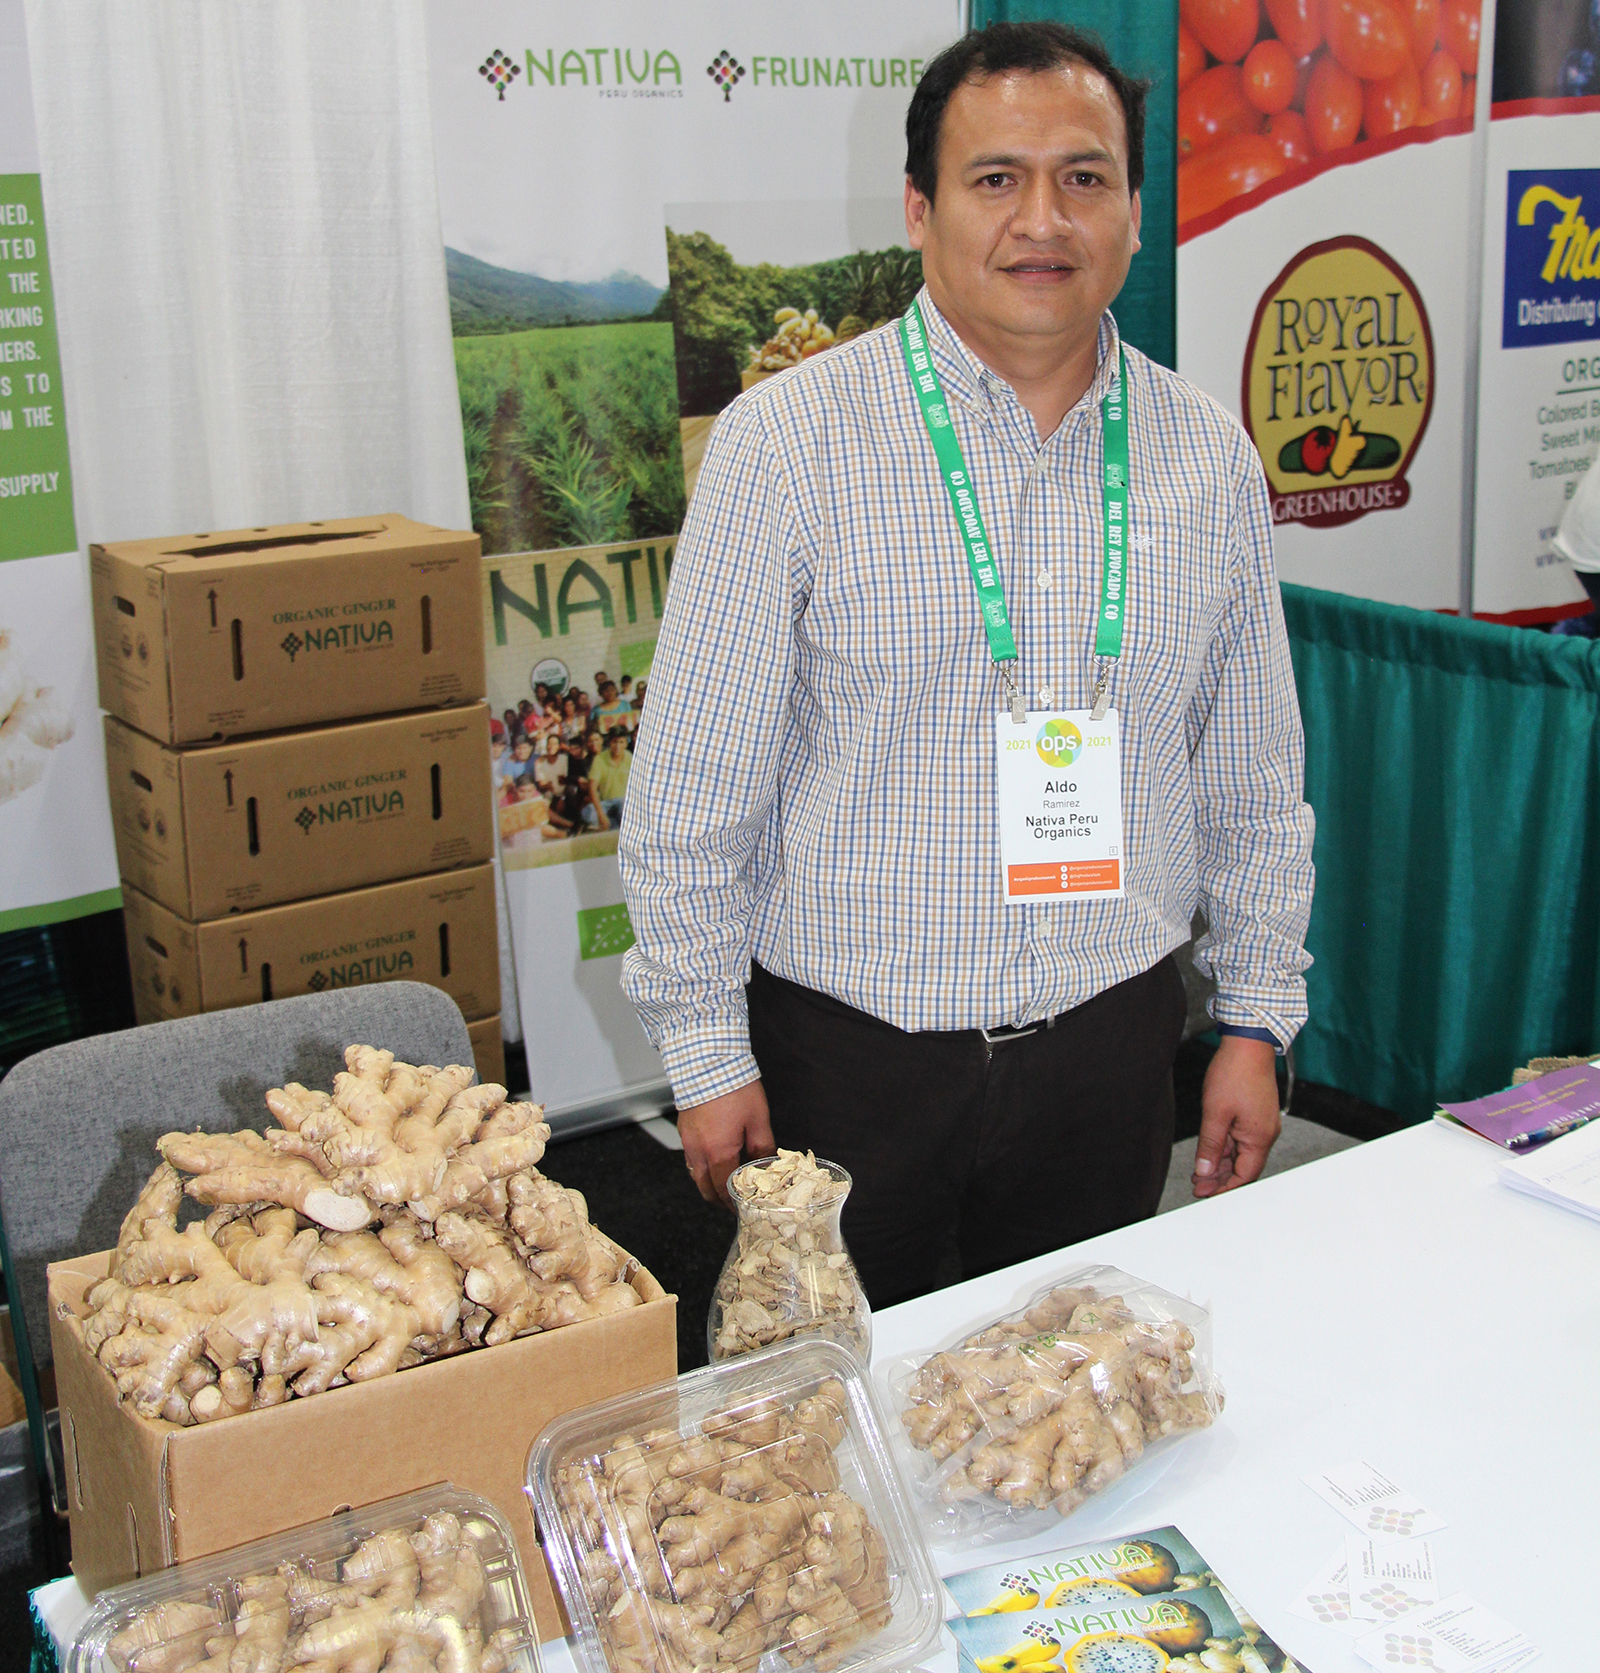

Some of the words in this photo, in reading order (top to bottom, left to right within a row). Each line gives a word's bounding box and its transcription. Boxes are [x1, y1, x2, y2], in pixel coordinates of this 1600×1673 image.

[525, 48, 683, 86] NATIVA
[752, 56, 925, 87] FRUNATURE
[599, 89, 629, 99] PERU
[632, 88, 684, 98] ORGANICS
[8, 272, 41, 294] THE
[1517, 295, 1596, 327] Distributing
[911, 350, 930, 372] REY
[25, 373, 50, 395] TO
[917, 371, 937, 394] DEL
[22, 406, 54, 428] THE
[1107, 406, 1122, 421] CO
[1537, 401, 1588, 425] Colored
[1541, 429, 1580, 452] Sweet
[949, 470, 966, 486] CO
[1529, 455, 1591, 480] Tomatoes
[0, 472, 59, 497] SUPPLY
[955, 488, 983, 540] AVOCADO
[1108, 501, 1122, 522] DEL
[1272, 484, 1395, 522] GREENHOUSE
[1108, 524, 1122, 547] REY
[971, 541, 990, 564] REY
[977, 564, 996, 588] DEL
[1106, 548, 1122, 601] AVOCADO
[273, 606, 340, 624] ORGANIC
[342, 599, 397, 616] GINGER
[1104, 604, 1119, 621] CO
[305, 620, 393, 652] NATIVA
[1006, 740, 1031, 750] 2021
[1041, 735, 1078, 756] ops
[1087, 736, 1112, 747] 2021
[287, 780, 352, 800] ORGANIC
[355, 769, 407, 788] GINGER
[1044, 781, 1077, 794] Aldo
[319, 790, 404, 825] NATIVA
[1043, 799, 1080, 809] Ramirez
[1025, 815, 1066, 827] Nativa
[1070, 813, 1099, 825] Peru
[1034, 827, 1091, 841] Organics
[300, 944, 362, 965] ORGANIC
[365, 930, 416, 950] GINGER
[330, 950, 414, 987] NATIVA
[1027, 1544, 1151, 1586] NATIVA
[1088, 1571, 1112, 1581] PERU
[1112, 1559, 1154, 1575] ORGANICS
[1053, 1602, 1185, 1637] NATIVA
[1117, 1627, 1140, 1636] PERU
[1141, 1619, 1188, 1632] ORGANICS
